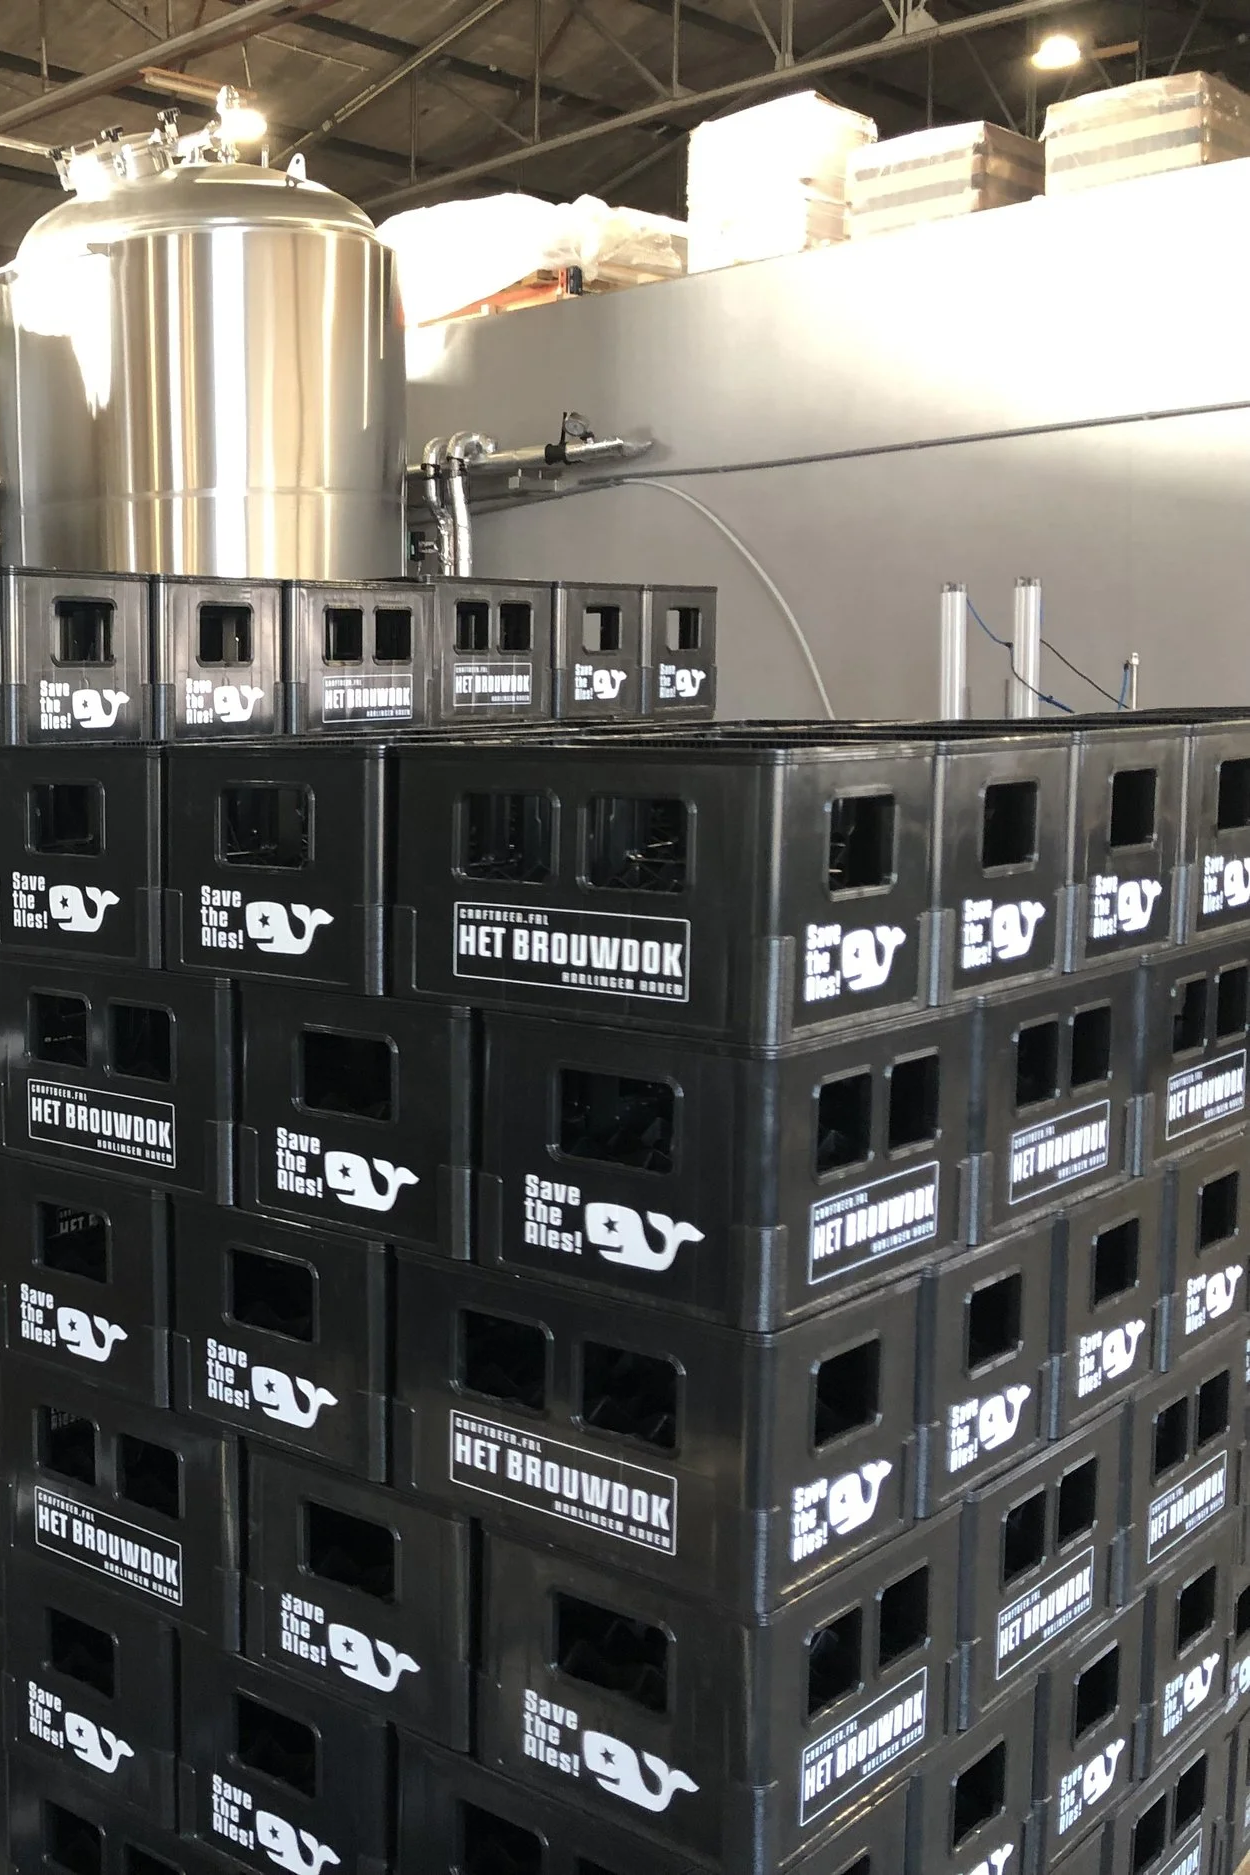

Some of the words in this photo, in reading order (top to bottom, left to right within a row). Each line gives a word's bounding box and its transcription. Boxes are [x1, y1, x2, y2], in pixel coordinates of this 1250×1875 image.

[40, 680, 70, 697] Save
[185, 678, 212, 694] Save
[39, 696, 61, 713] the
[185, 693, 204, 709] the
[40, 712, 71, 729] Ales!
[11, 871, 46, 892] Save
[200, 884, 242, 908] Save
[11, 889, 36, 910] the
[964, 898, 991, 923] Save
[12, 908, 48, 929] Ales!
[199, 905, 229, 928] the
[200, 926, 244, 950] Ales!
[807, 923, 840, 950] Save
[963, 922, 982, 945] the
[458, 923, 506, 958] HET
[512, 928, 682, 976] BROUWDOK
[806, 949, 829, 975] the
[31, 1096, 61, 1126] HET
[65, 1102, 171, 1148] BROUWDOK
[276, 1126, 321, 1155] Save
[275, 1147, 307, 1173] the
[276, 1168, 323, 1198] Ales!
[525, 1173, 581, 1206] Save
[523, 1197, 562, 1226] the
[524, 1220, 582, 1254] Ales!
[20, 1282, 54, 1310] Save
[19, 1301, 44, 1325] the
[20, 1319, 56, 1347] Ales!
[206, 1337, 248, 1368] Save
[206, 1357, 235, 1384] the
[207, 1377, 250, 1410] Ales!
[454, 1432, 500, 1474] HET
[506, 1449, 669, 1529] BROUWDOK
[794, 1478, 826, 1513] Save
[793, 1508, 816, 1536] the
[37, 1504, 68, 1538] HET
[72, 1518, 178, 1585] BROUWDOK
[280, 1589, 325, 1624] Save
[280, 1609, 311, 1639] the
[281, 1629, 327, 1666] Ales!
[28, 1680, 62, 1712] Save
[524, 1688, 578, 1730] Save
[27, 1698, 52, 1725] the
[29, 1715, 64, 1749] Ales!
[522, 1710, 561, 1745] the
[523, 1733, 580, 1777] Ales!
[804, 1752, 834, 1801] HET
[836, 1690, 923, 1777] BROUWDOK
[211, 1773, 252, 1810] Save
[211, 1792, 240, 1823] the
[212, 1811, 254, 1850] Ales!
